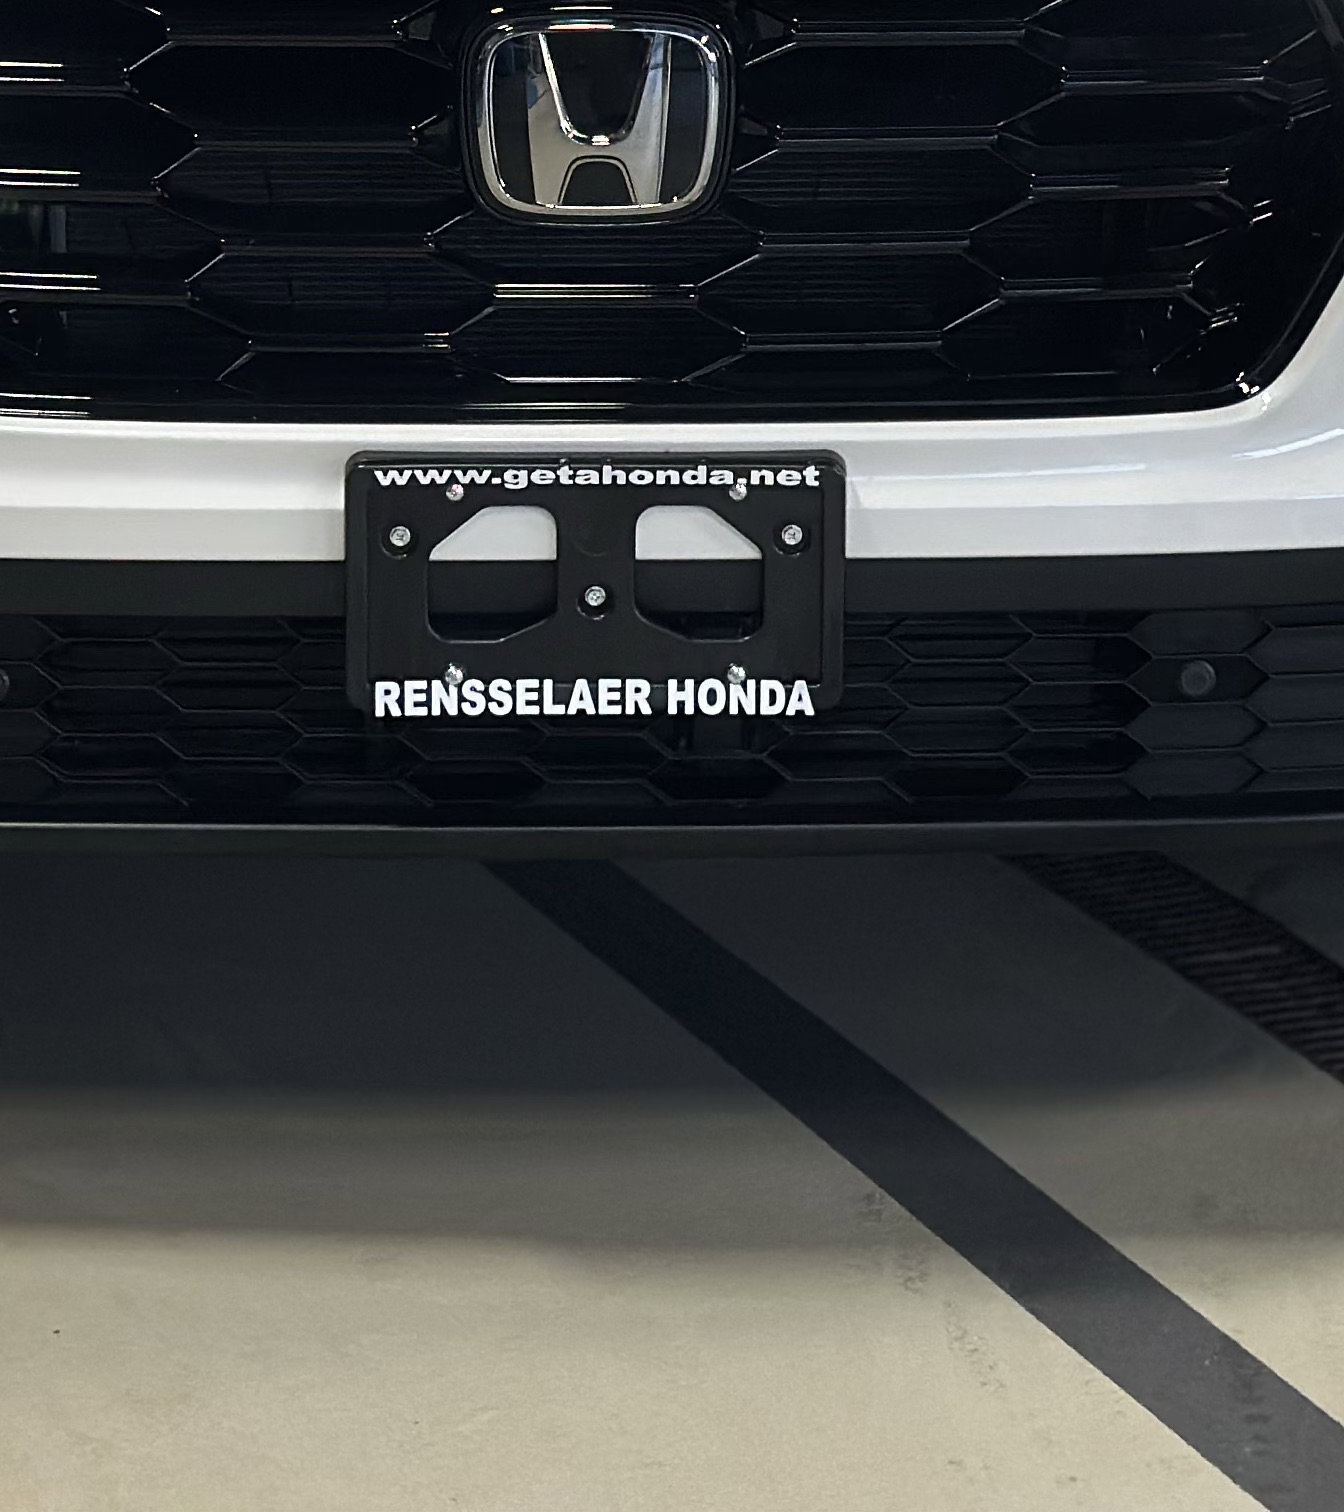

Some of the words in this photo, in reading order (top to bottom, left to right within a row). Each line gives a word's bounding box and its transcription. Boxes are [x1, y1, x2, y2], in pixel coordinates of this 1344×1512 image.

[374, 467, 820, 489] www.getahonda.net
[374, 678, 653, 718] RENSSELAER
[667, 678, 816, 716] HONDA
